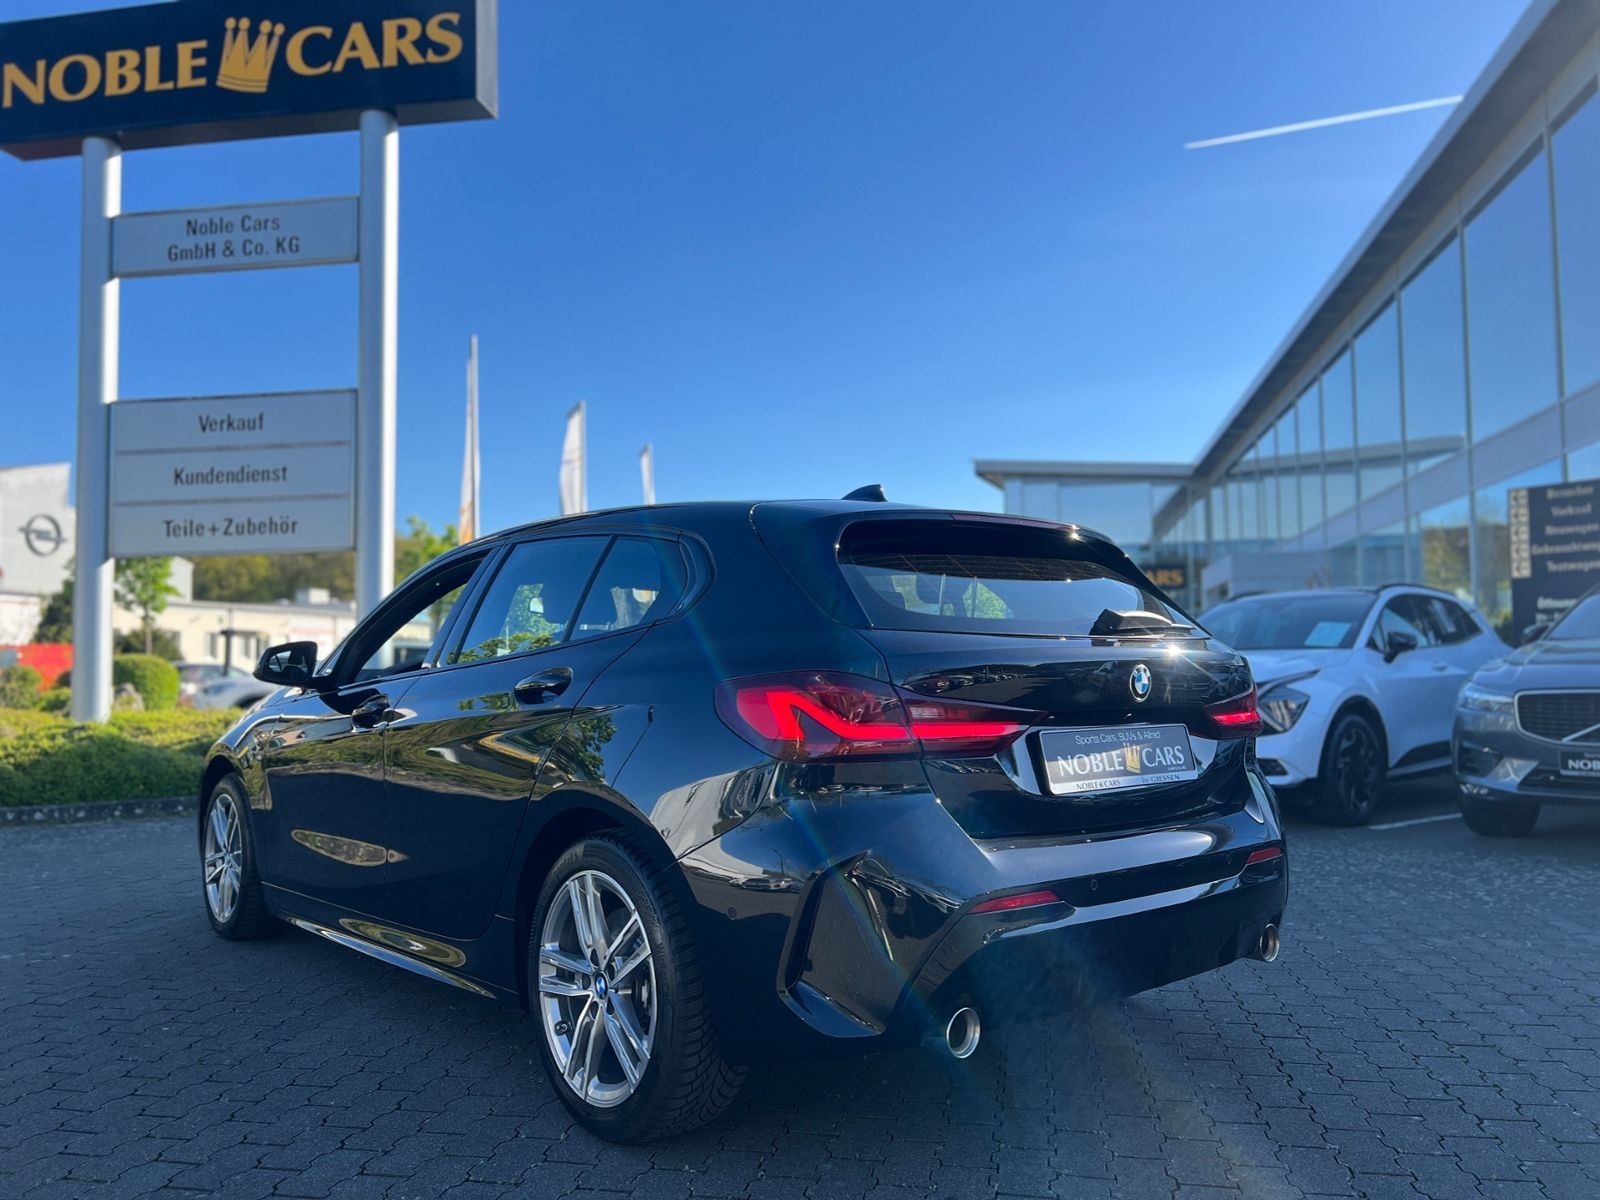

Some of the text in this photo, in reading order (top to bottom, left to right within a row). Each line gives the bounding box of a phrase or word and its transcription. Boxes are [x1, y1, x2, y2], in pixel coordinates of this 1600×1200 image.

[3, 13, 464, 108] NOBLE CARS
[186, 214, 281, 237] Noble Cars
[167, 235, 301, 262] GmbH & Co. KG
[198, 411, 265, 433] Verkauf
[173, 465, 288, 486] Kundendienst
[163, 515, 299, 539] Teile+Zubehör
[1074, 735, 1100, 748] Sports
[1057, 745, 1185, 776] NOBLE CARS
[1076, 779, 1121, 791] NOBLE CARS
[1150, 774, 1181, 783] GIESSEN
